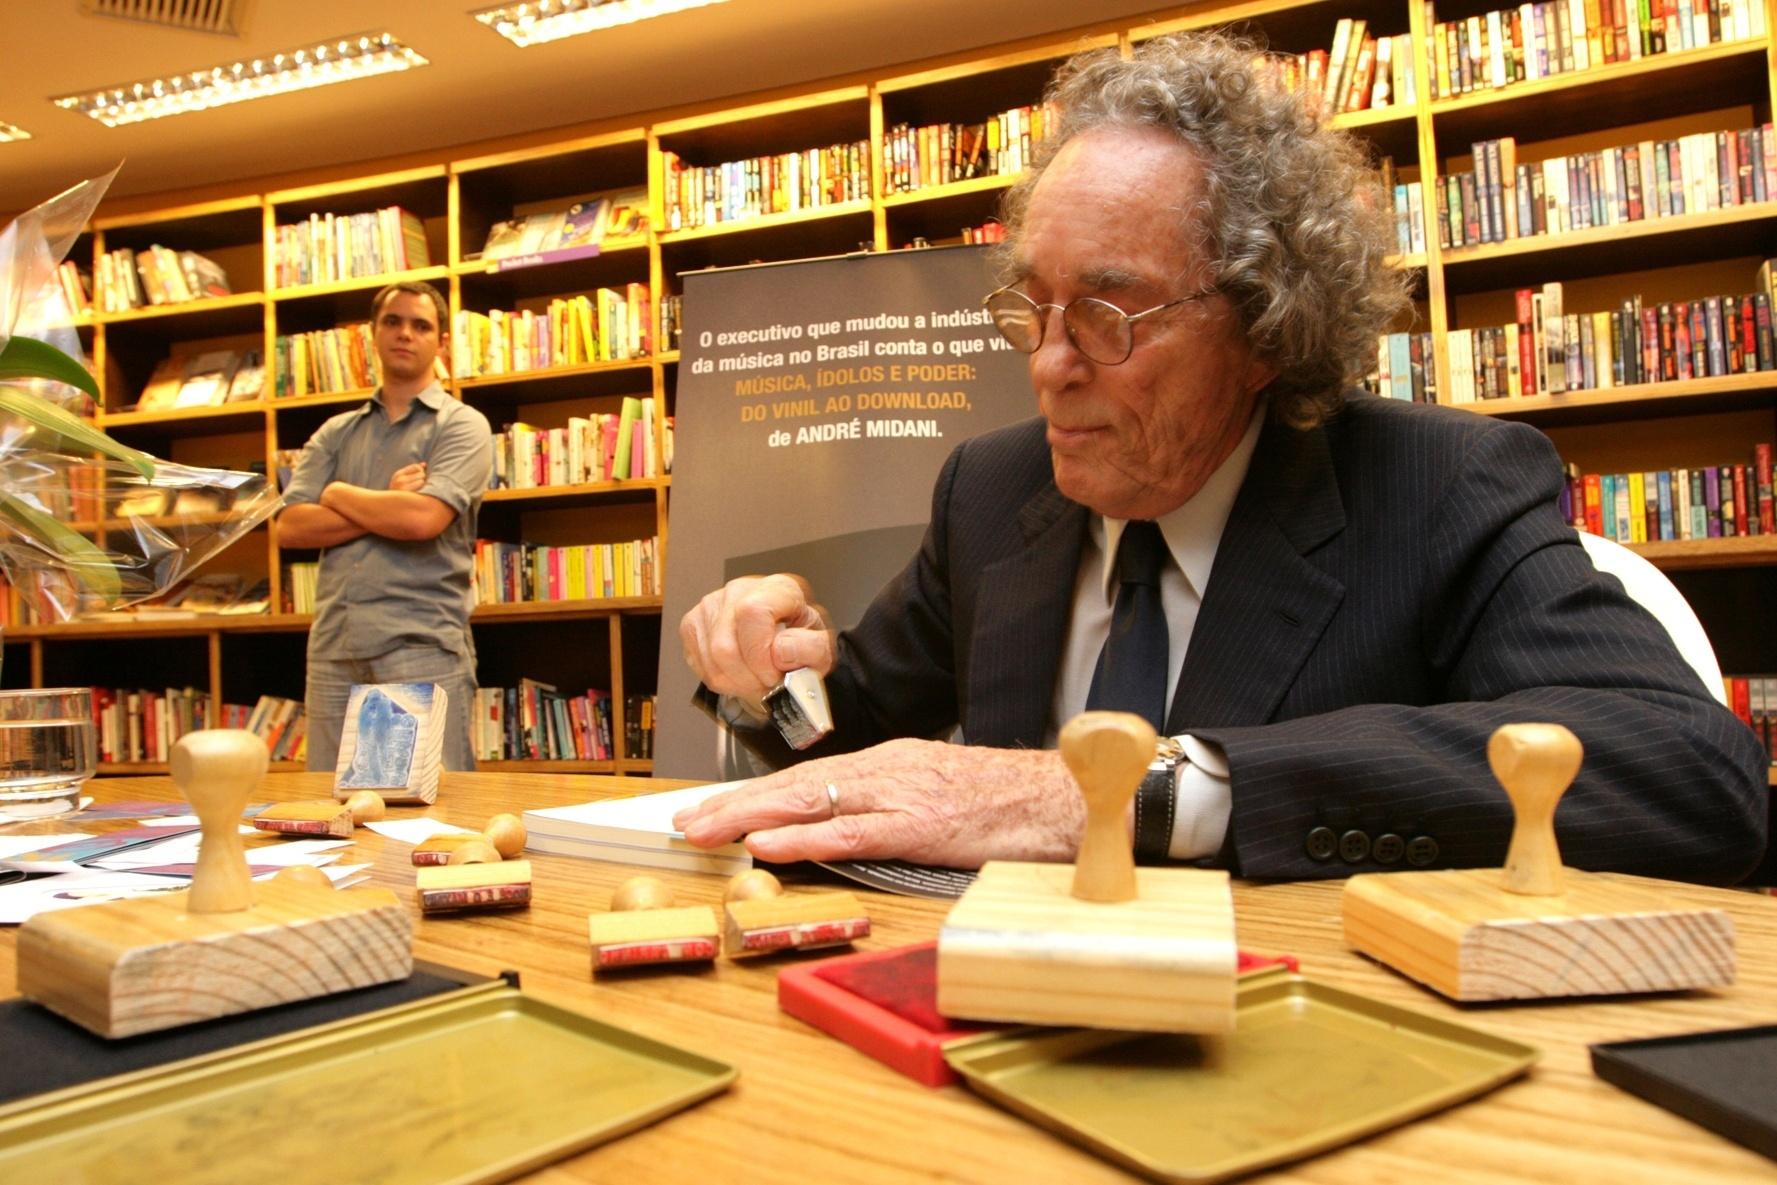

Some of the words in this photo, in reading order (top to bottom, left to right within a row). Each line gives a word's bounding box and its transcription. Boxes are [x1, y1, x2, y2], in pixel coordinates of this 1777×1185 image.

[700, 331, 712, 347] O
[717, 324, 803, 346] executivo
[807, 321, 841, 340] que
[846, 313, 909, 332] mudou
[914, 315, 926, 328] a
[691, 358, 714, 374] da
[718, 353, 784, 371] música
[789, 350, 812, 364] no
[817, 340, 869, 361] Brasil
[874, 338, 927, 356] conta
[932, 340, 944, 354] o
[949, 337, 984, 357] que
[735, 374, 812, 396] MÚSICA,
[816, 366, 884, 387] ÍDOLOS
[890, 365, 902, 381] E
[907, 364, 976, 381] PODER:
[741, 404, 767, 422] DO
[772, 399, 820, 418] VINIL
[825, 395, 851, 413] AO
[857, 392, 972, 411] DOWNLOAD,
[768, 430, 791, 447] de
[796, 417, 861, 444] ANDRÉ
[866, 419, 943, 438] MIDANI.
